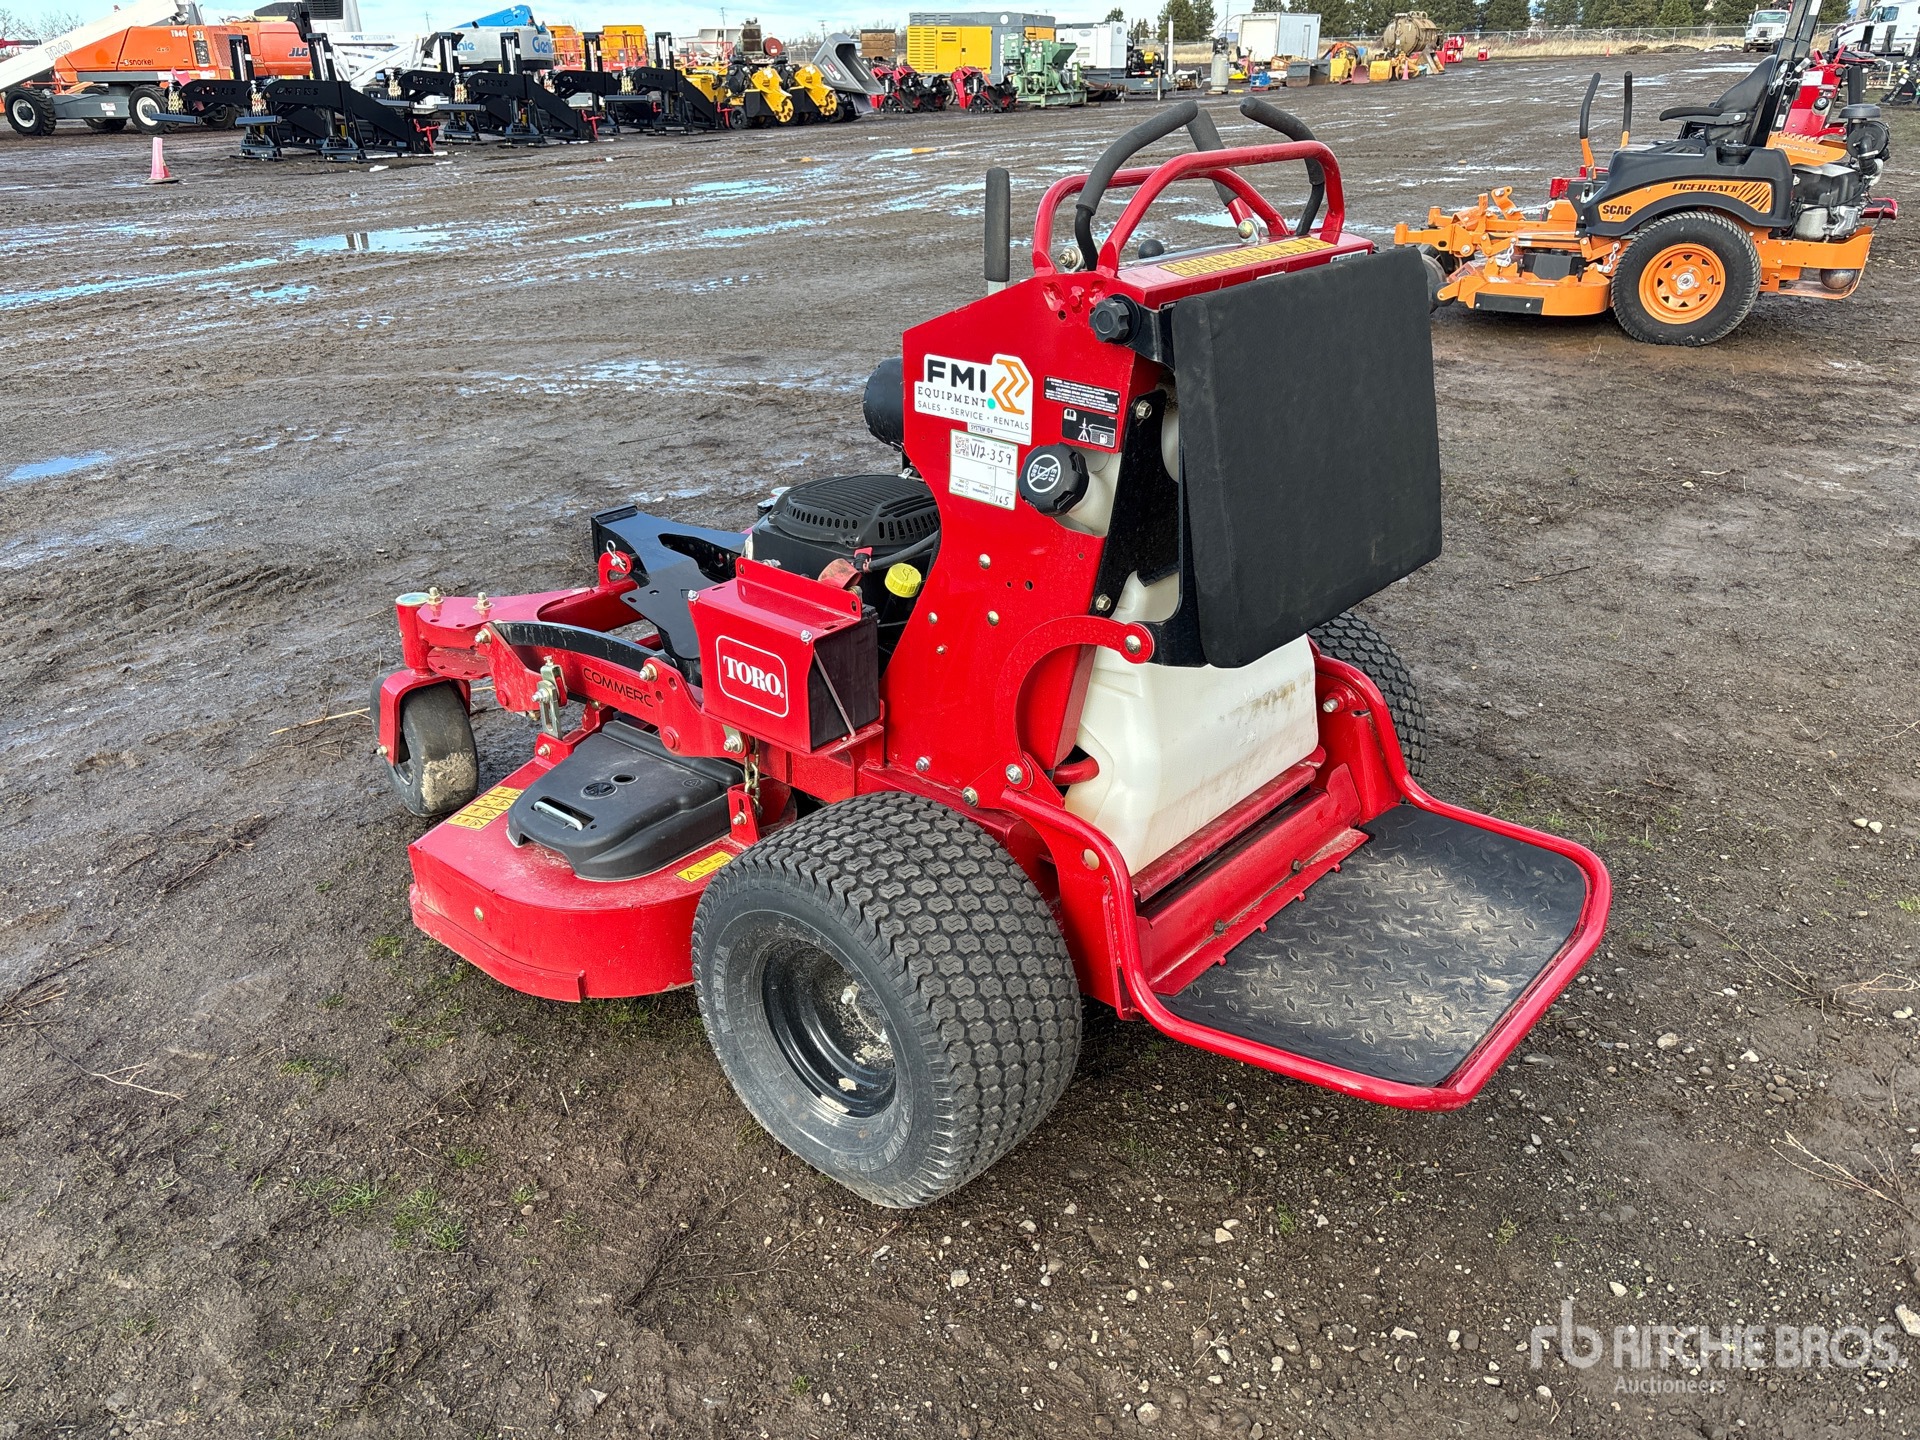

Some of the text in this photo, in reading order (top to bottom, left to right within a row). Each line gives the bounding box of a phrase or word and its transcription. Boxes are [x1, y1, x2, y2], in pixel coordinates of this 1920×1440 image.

[288, 47, 308, 57] JLG
[1672, 183, 1706, 192] TIGER
[1707, 184, 1729, 192] CAT
[1602, 205, 1632, 216] SCAG
[927, 359, 987, 393] FMI
[917, 386, 986, 408] EQUIPMENT
[917, 400, 1030, 431] SALES SERVICE RENTALS
